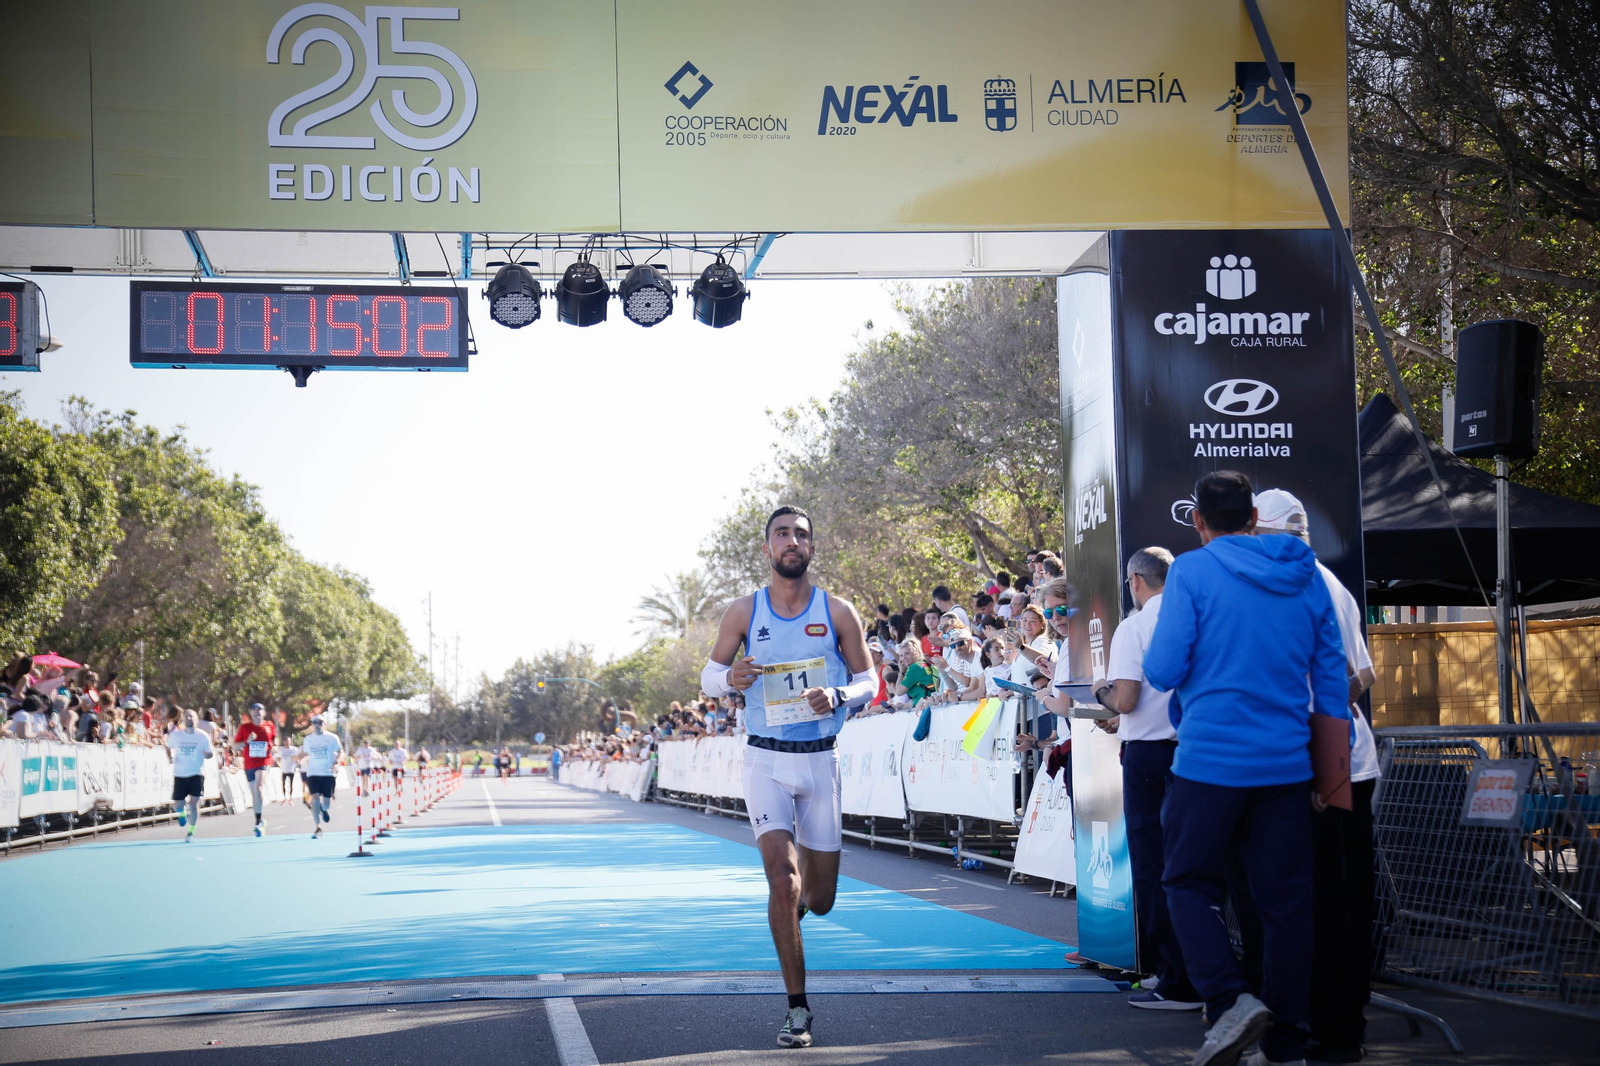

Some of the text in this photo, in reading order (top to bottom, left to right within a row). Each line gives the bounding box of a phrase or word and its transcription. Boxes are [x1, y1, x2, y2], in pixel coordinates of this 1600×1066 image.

[266, 2, 479, 151] 25
[1047, 72, 1187, 104] ALMERÍA
[817, 75, 958, 136] NEXAL
[665, 114, 787, 132] COOPERACIÓN
[1047, 109, 1119, 126] CIUDAD
[665, 131, 707, 146] 2005
[710, 131, 741, 140] Deporte,
[829, 126, 857, 136] 2020
[1226, 134, 1283, 143] DEPORTES
[1240, 145, 1288, 154] ALMERIA
[268, 157, 480, 203] EDICIÓN
[187, 291, 452, 358] 01:15:02
[1154, 302, 1311, 345] cajamar
[1230, 337, 1307, 348] CAJA RURAL
[1189, 423, 1293, 439] HYUNDAI
[1193, 443, 1291, 458] Almerialva
[1074, 478, 1108, 545] NEXAL
[783, 670, 808, 691] 11
